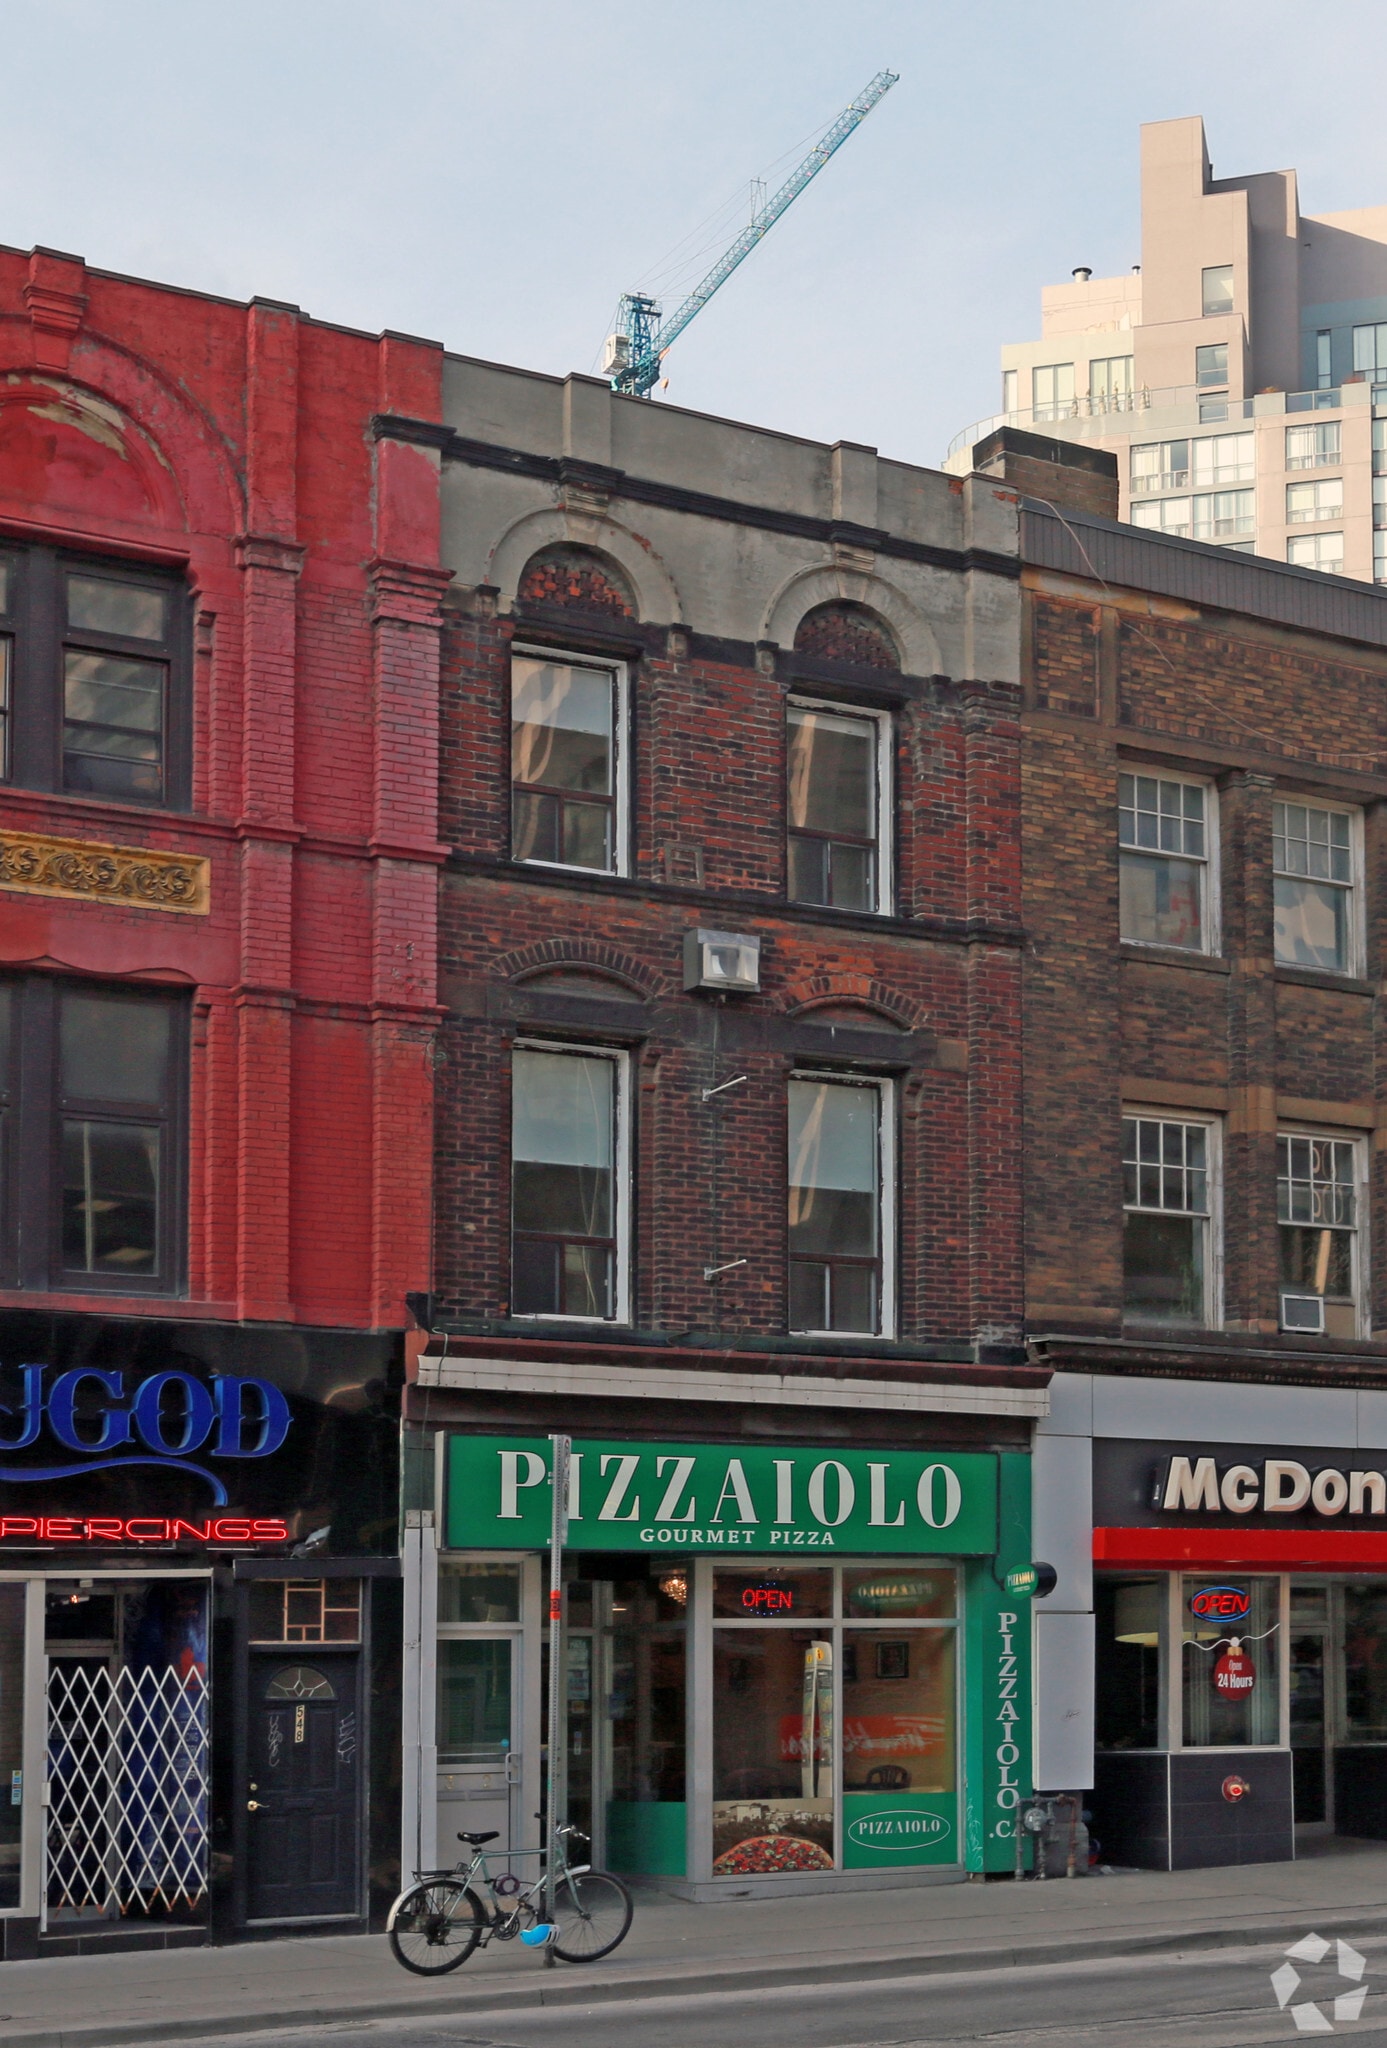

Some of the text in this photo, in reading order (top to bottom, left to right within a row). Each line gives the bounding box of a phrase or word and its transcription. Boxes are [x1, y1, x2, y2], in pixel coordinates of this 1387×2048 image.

[496, 1449, 963, 1530] PIZZAIOLO
[1163, 1456, 1387, 1516] McDon
[0, 1517, 289, 1541] PIERCINGS
[640, 1528, 836, 1546] GOURMET PIZZA
[742, 1588, 793, 1610] OPEN
[1192, 1594, 1250, 1615] OPEN
[1228, 1659, 1243, 1672] Open
[1217, 1672, 1253, 1689] 24 Hours
[995, 1612, 1021, 1810] PIZZAIOLO
[296, 1706, 304, 1741] 548
[858, 1819, 941, 1836] PIZZAIOLO
